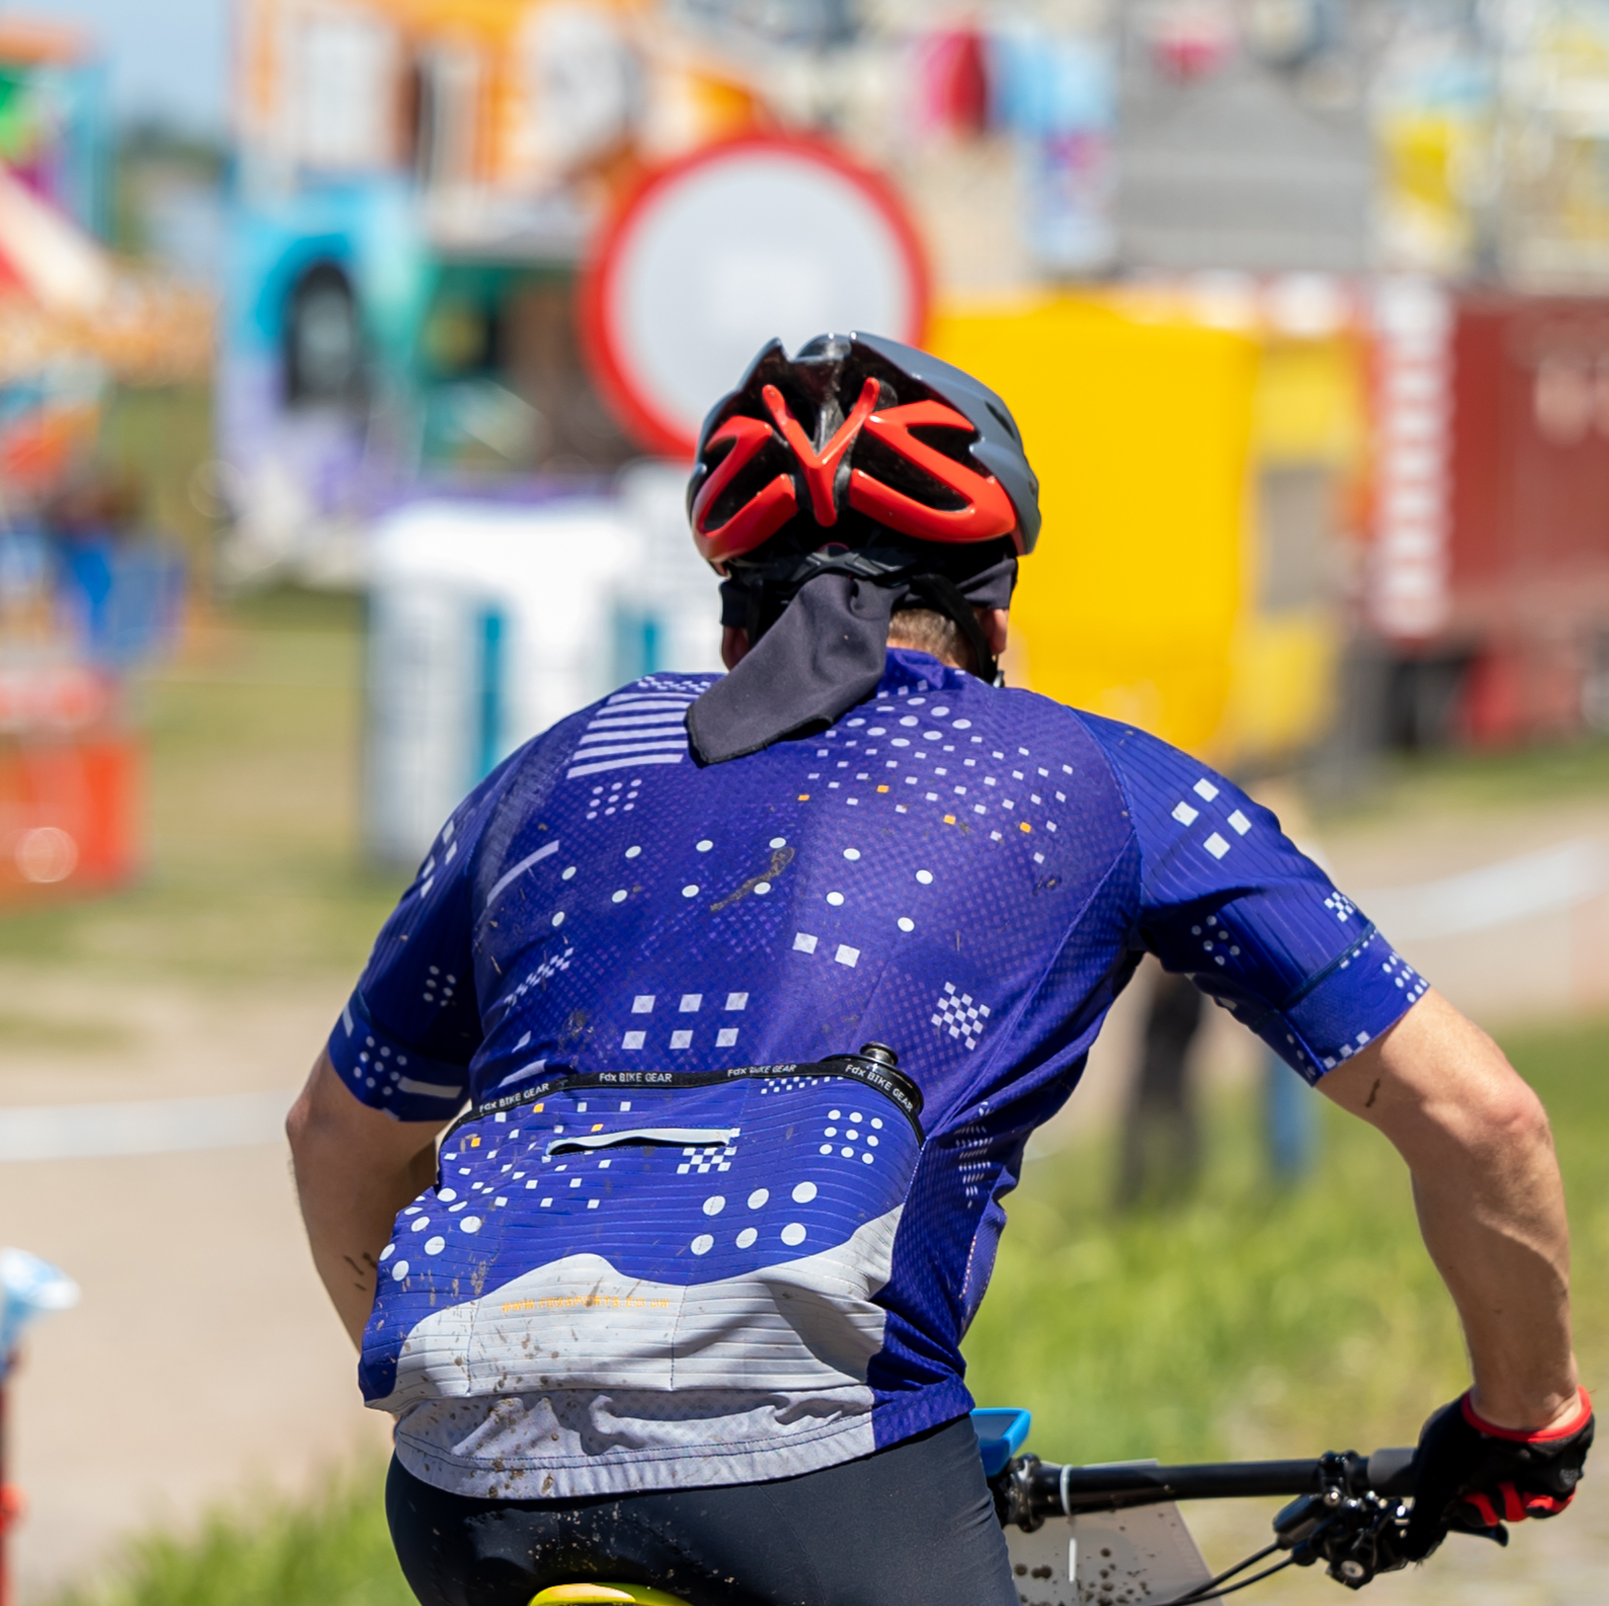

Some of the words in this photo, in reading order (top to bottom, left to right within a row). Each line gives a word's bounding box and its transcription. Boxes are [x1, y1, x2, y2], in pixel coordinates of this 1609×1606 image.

[618, 1072, 643, 1083] BIKE
[644, 1073, 673, 1083] GEAR
[748, 1065, 770, 1075] BIKE
[771, 1064, 797, 1075] GEAR
[498, 1093, 522, 1108] BIKE
[523, 1083, 550, 1099] GEAR
[867, 1071, 892, 1092] BIKE
[892, 1086, 915, 1113] GEAR
